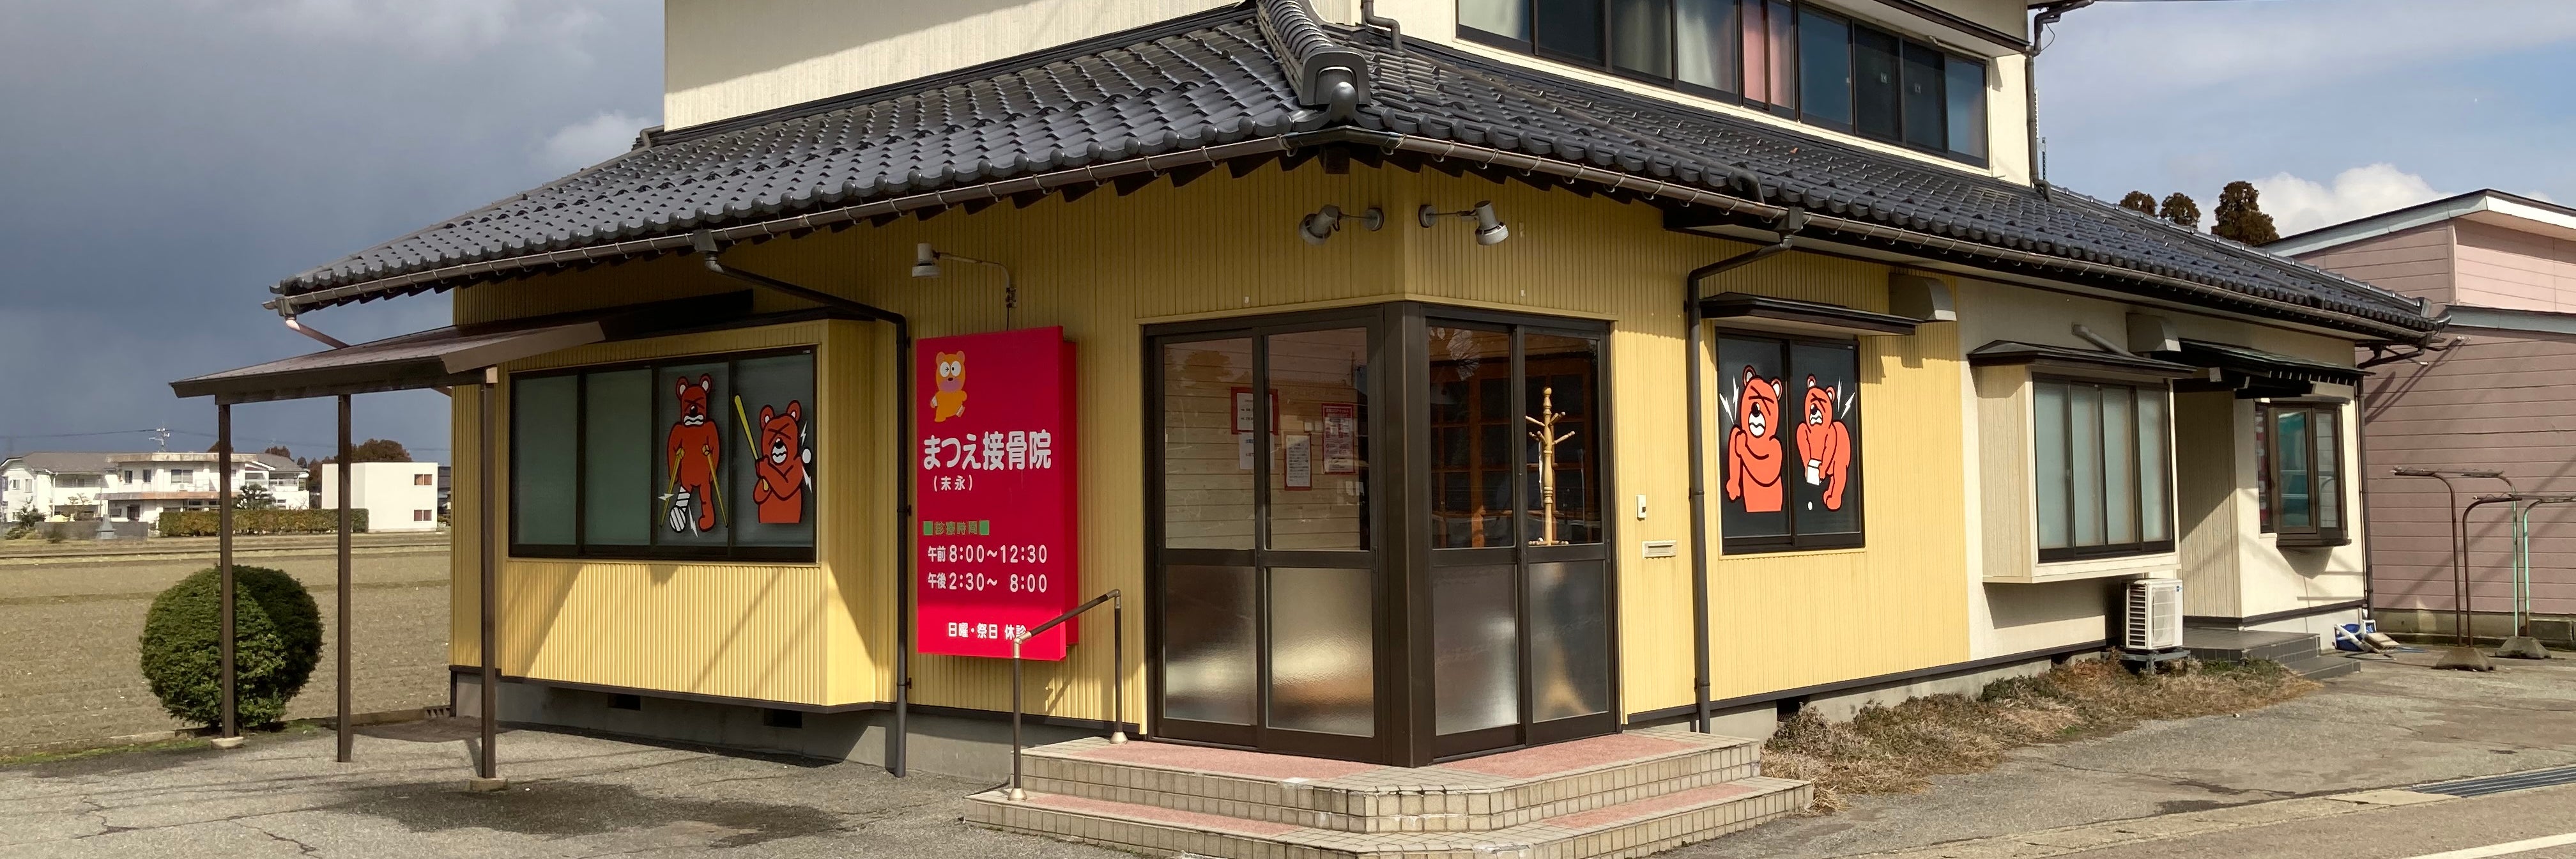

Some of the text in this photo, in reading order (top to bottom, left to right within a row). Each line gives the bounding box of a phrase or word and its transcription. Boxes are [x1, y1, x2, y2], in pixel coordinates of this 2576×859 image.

[924, 429, 1052, 470] まつえ接骨院
[928, 545, 946, 562] 午前
[928, 572, 946, 589] 午後
